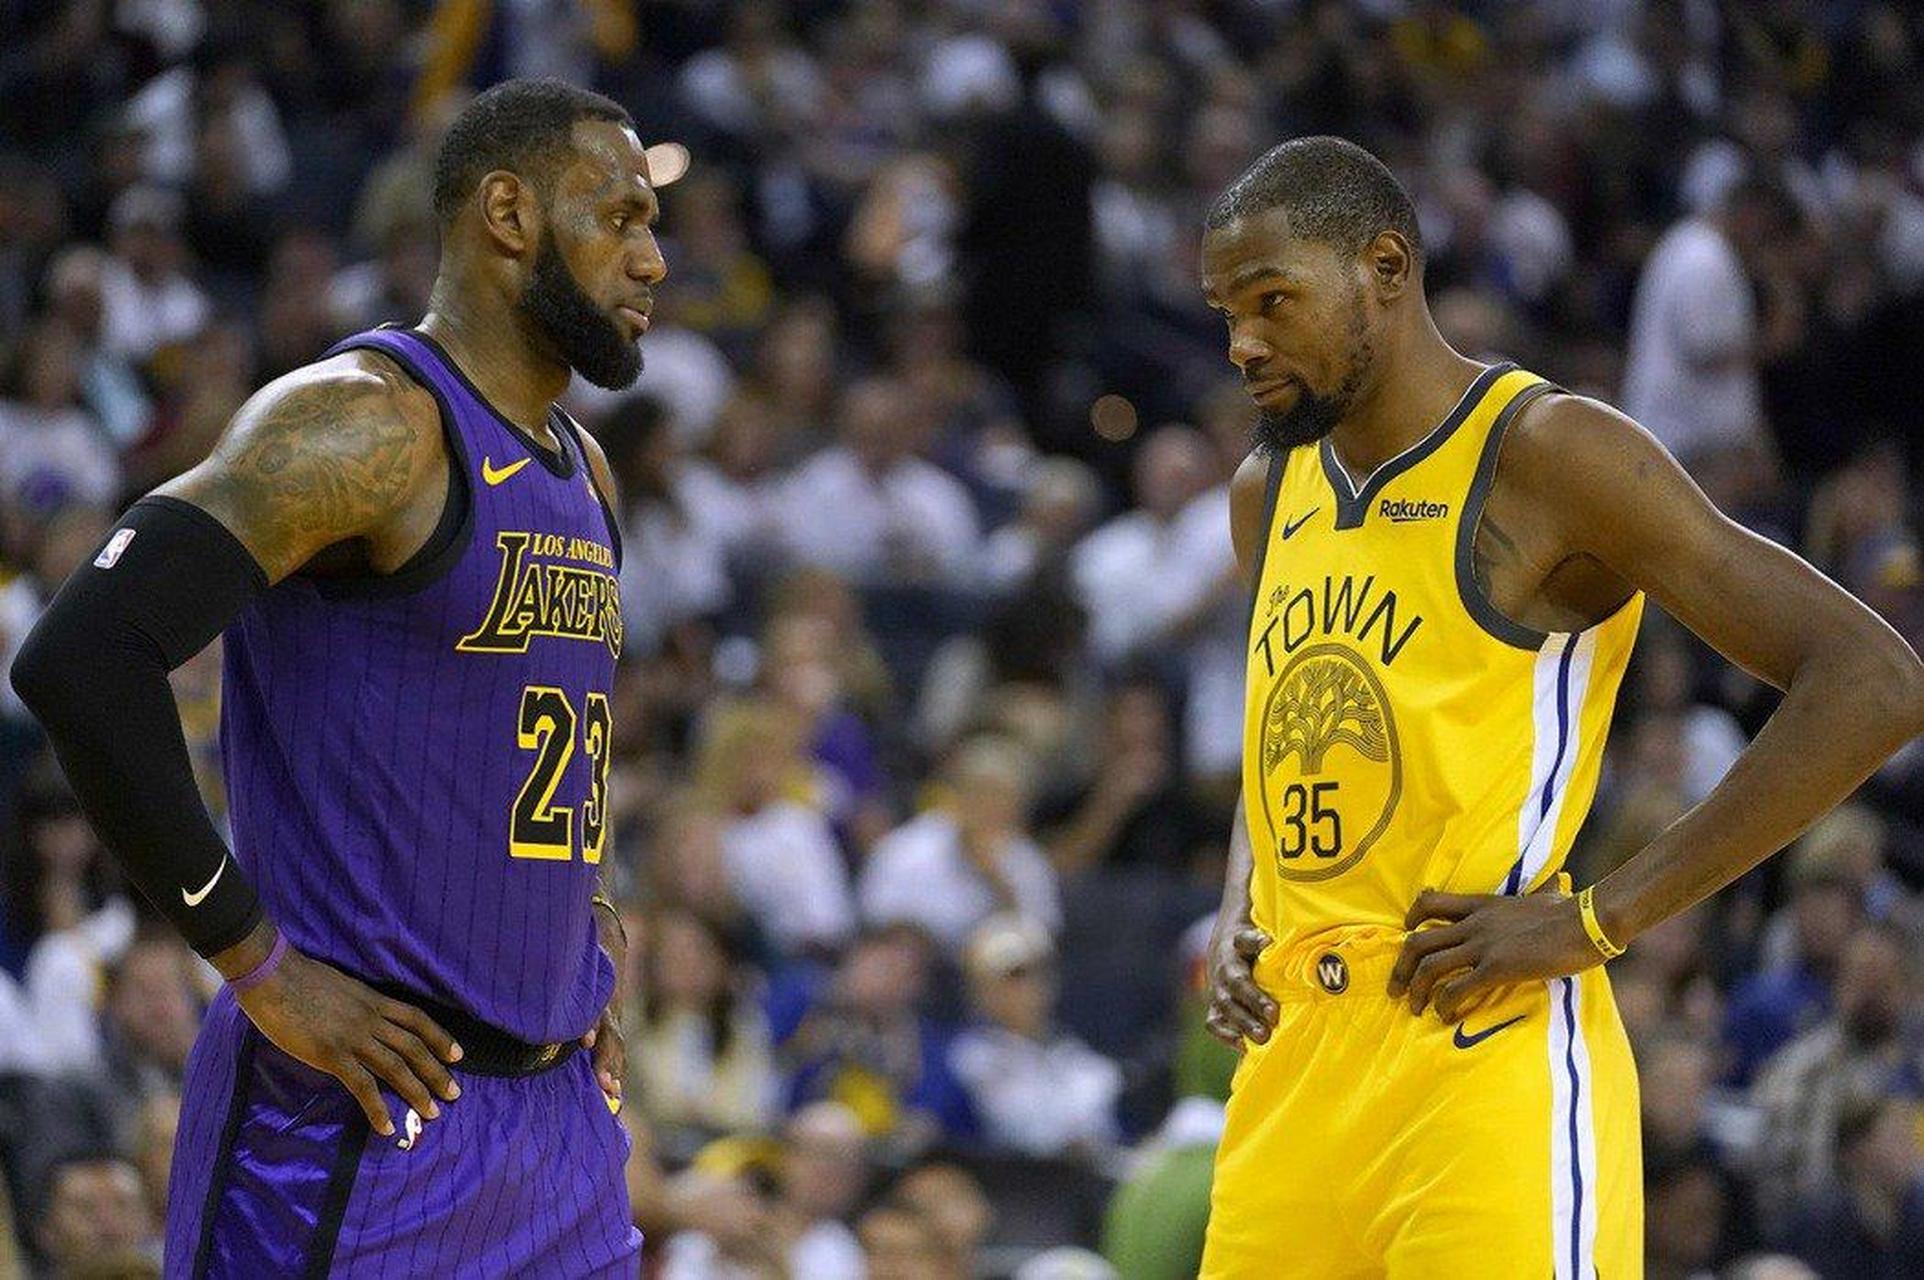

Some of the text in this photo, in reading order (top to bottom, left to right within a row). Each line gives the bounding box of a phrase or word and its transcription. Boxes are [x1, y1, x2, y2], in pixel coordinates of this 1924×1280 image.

[532, 533, 566, 557] LOS
[1379, 500, 1449, 519] Rakuten
[455, 531, 623, 660] LAKERS
[1254, 575, 1424, 677] TOWN
[510, 686, 613, 865] 23
[1281, 781, 1342, 859] 35
[1318, 963, 1343, 986] W
